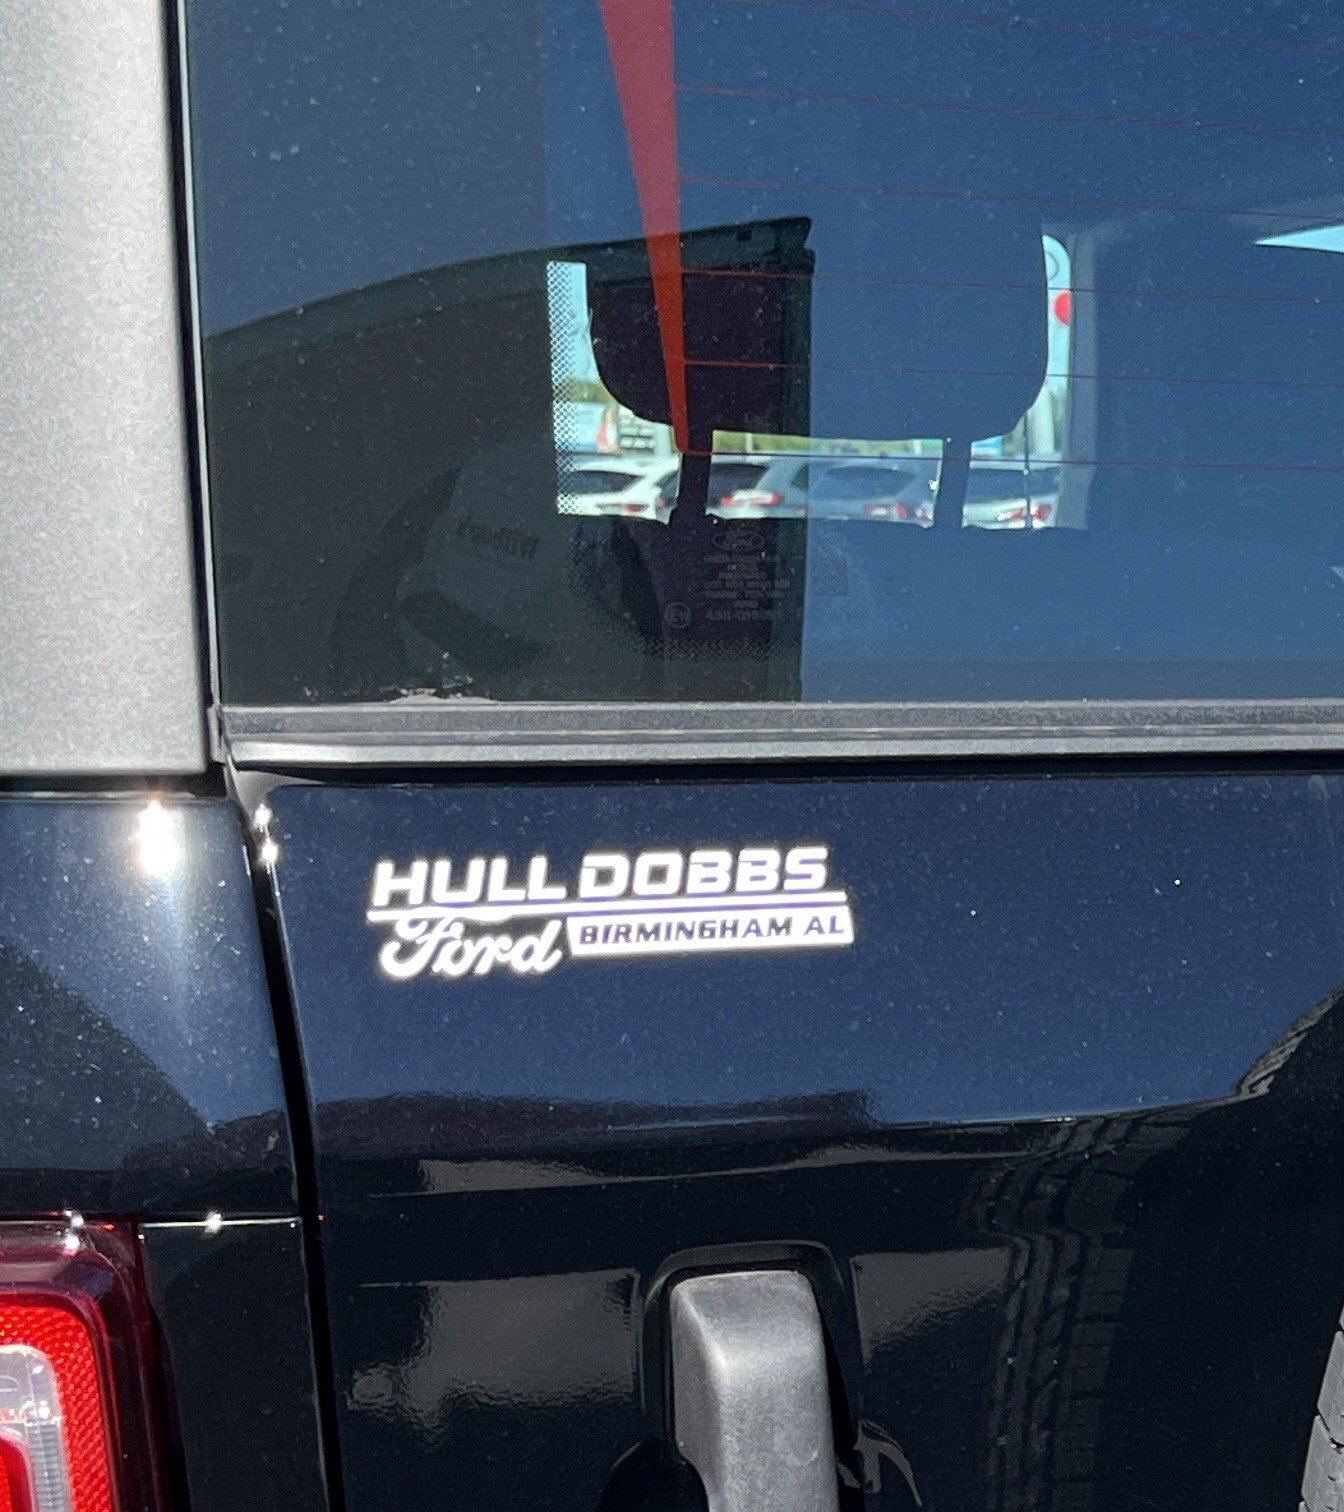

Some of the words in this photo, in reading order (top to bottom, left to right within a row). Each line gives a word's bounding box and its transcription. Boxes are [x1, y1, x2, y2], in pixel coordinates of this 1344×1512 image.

[372, 854, 567, 906] HULL
[578, 847, 829, 898] DOBBS
[380, 910, 563, 979] Ford
[578, 918, 793, 946] BIRMINGHAM
[804, 916, 846, 935] AL
